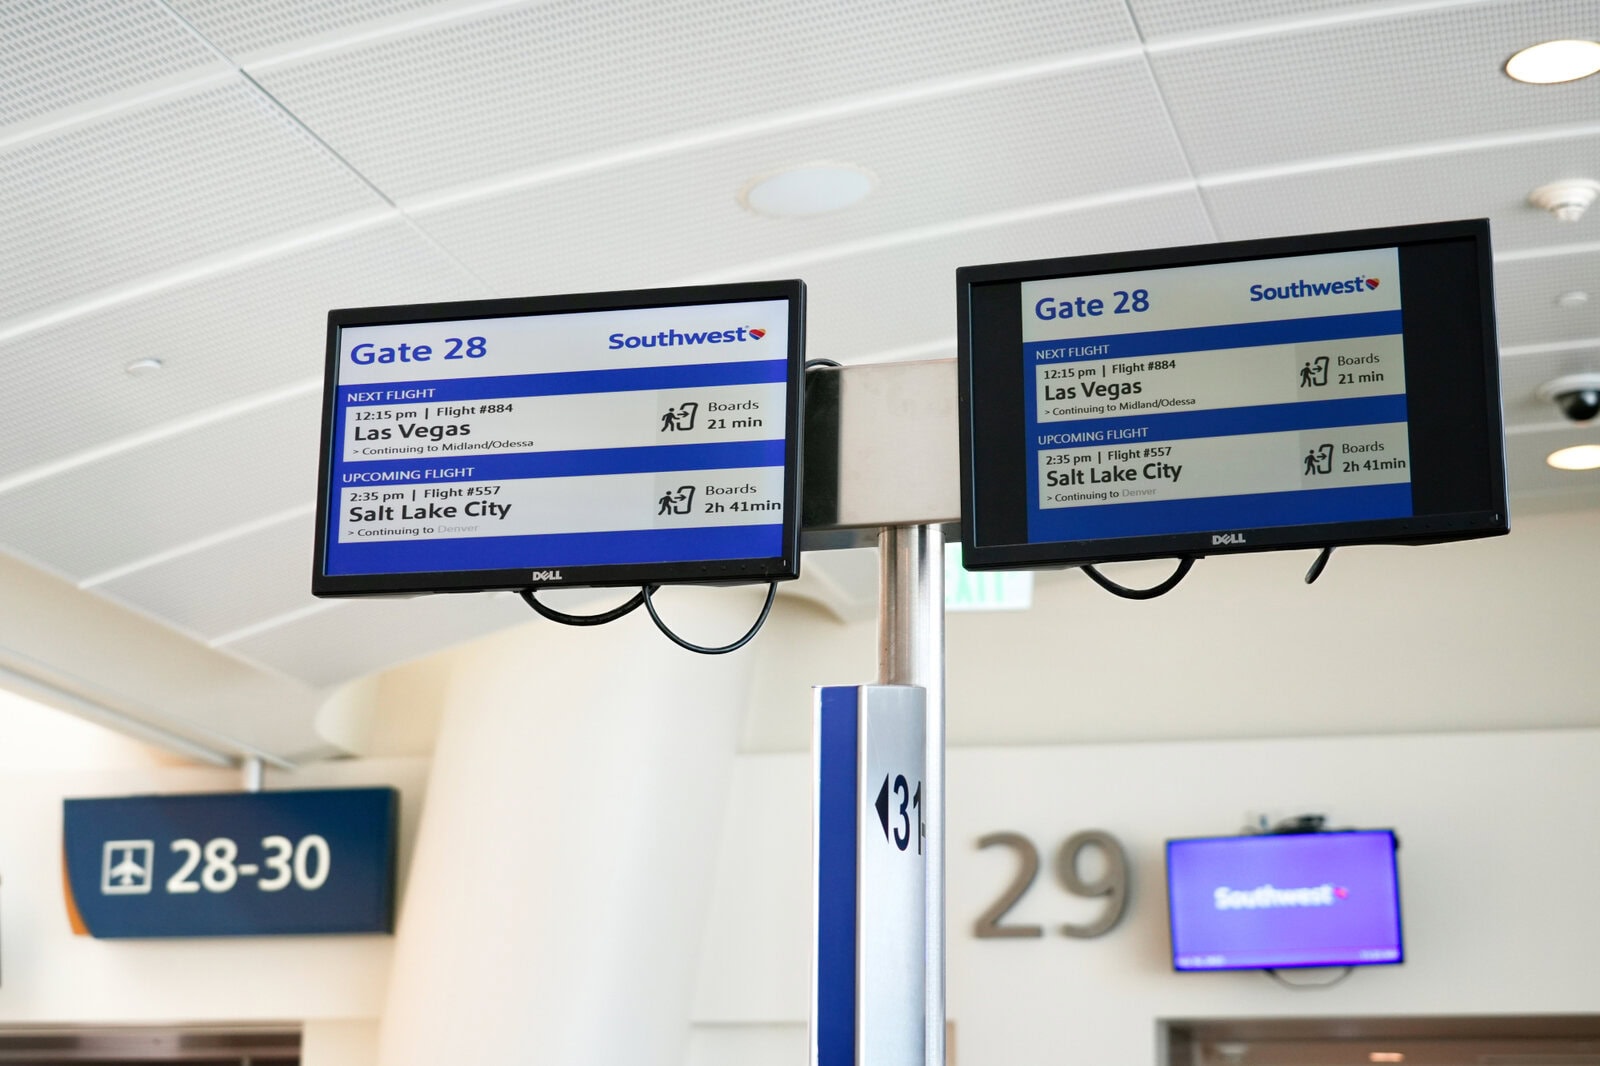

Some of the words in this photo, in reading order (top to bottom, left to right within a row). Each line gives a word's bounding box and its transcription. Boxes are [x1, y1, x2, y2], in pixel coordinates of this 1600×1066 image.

[1250, 276, 1364, 301] Southwest
[1035, 297, 1104, 321] Gate
[1113, 289, 1150, 314] 28
[609, 327, 747, 350] Southwest
[350, 343, 432, 365] Gate
[444, 336, 487, 360] 28
[1036, 348, 1066, 360] NEXT
[1069, 344, 1110, 357] FLIGHT
[1337, 353, 1381, 367] Boards
[1044, 368, 1075, 380] 12:15
[1078, 368, 1096, 379] pm
[1112, 362, 1145, 376] Flight
[1148, 360, 1176, 371] #884
[1338, 373, 1354, 385] 21
[1358, 371, 1384, 383] min
[347, 391, 383, 402] NEXT
[387, 388, 436, 400] FLIGHT
[1045, 385, 1076, 401] Las
[1081, 381, 1142, 400] Vegas
[355, 411, 392, 421] 12:15
[395, 411, 417, 421] pm
[437, 406, 476, 418] Flight
[479, 404, 513, 414] #884
[708, 400, 759, 412] Boards
[1052, 405, 1105, 416] Continuing
[1107, 404, 1117, 412] to
[1119, 398, 1196, 410] Midland/Odessa
[354, 426, 392, 441] Las
[398, 423, 471, 441] Vegas
[707, 419, 727, 430] 21
[732, 418, 763, 428] min
[1038, 431, 1104, 445] UPCOMING
[1107, 427, 1149, 440] FLIGHT
[362, 446, 424, 456] Continuing
[427, 444, 439, 452] to
[442, 439, 534, 451] Midland/Odessa
[1342, 441, 1385, 454] Boards
[1046, 454, 1070, 465] 2:35
[1073, 454, 1092, 465] pm
[1108, 449, 1141, 462] Flight
[1143, 447, 1172, 458] #557
[1342, 461, 1360, 473] 2h
[1363, 458, 1406, 471] 41min
[343, 470, 421, 483] UPCOMING
[425, 467, 475, 479] FLIGHT
[1047, 469, 1084, 487] Salt
[1090, 466, 1137, 484] Lake
[1143, 462, 1182, 482] City
[350, 491, 379, 501] 2:35
[382, 491, 404, 502] pm
[424, 488, 463, 500] Flight
[467, 486, 501, 496] #557
[705, 483, 757, 496] Boards
[1055, 492, 1107, 502] Continuing
[1109, 490, 1119, 498] to
[1122, 488, 1157, 497] Denver
[349, 505, 394, 522] Salt
[401, 503, 457, 520] Lake
[464, 500, 512, 520] City
[704, 502, 725, 514] 2h
[729, 500, 781, 512] 41min
[357, 527, 420, 537] Continuing
[422, 526, 434, 534] to
[438, 524, 479, 533] Denver
[1212, 533, 1246, 545] DELL
[532, 571, 562, 581] DELL
[166, 834, 331, 894] 28-30
[973, 829, 1131, 940] 29
